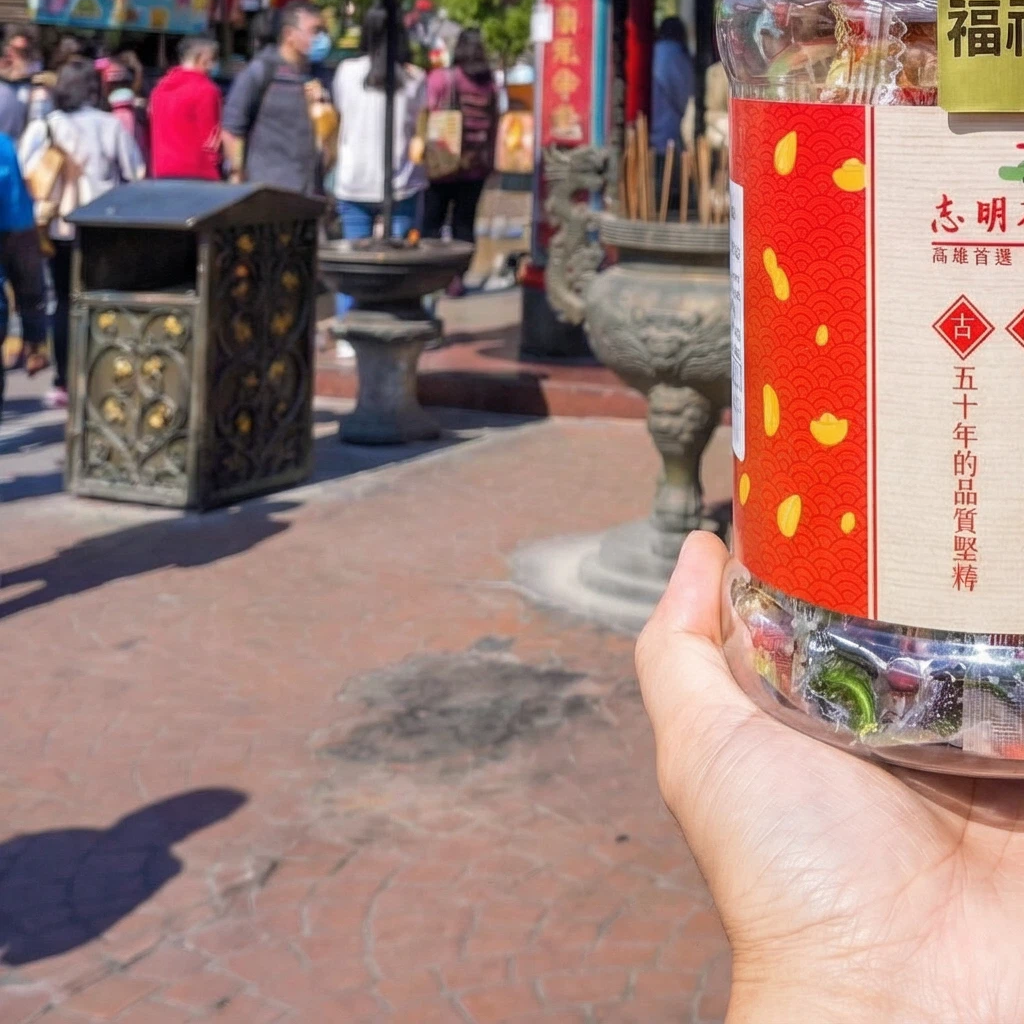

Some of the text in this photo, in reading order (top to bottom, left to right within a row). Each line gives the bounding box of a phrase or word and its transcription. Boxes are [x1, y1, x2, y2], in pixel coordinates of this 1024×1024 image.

[932, 247, 1013, 266] 高雄首選
[950, 313, 975, 340] 古
